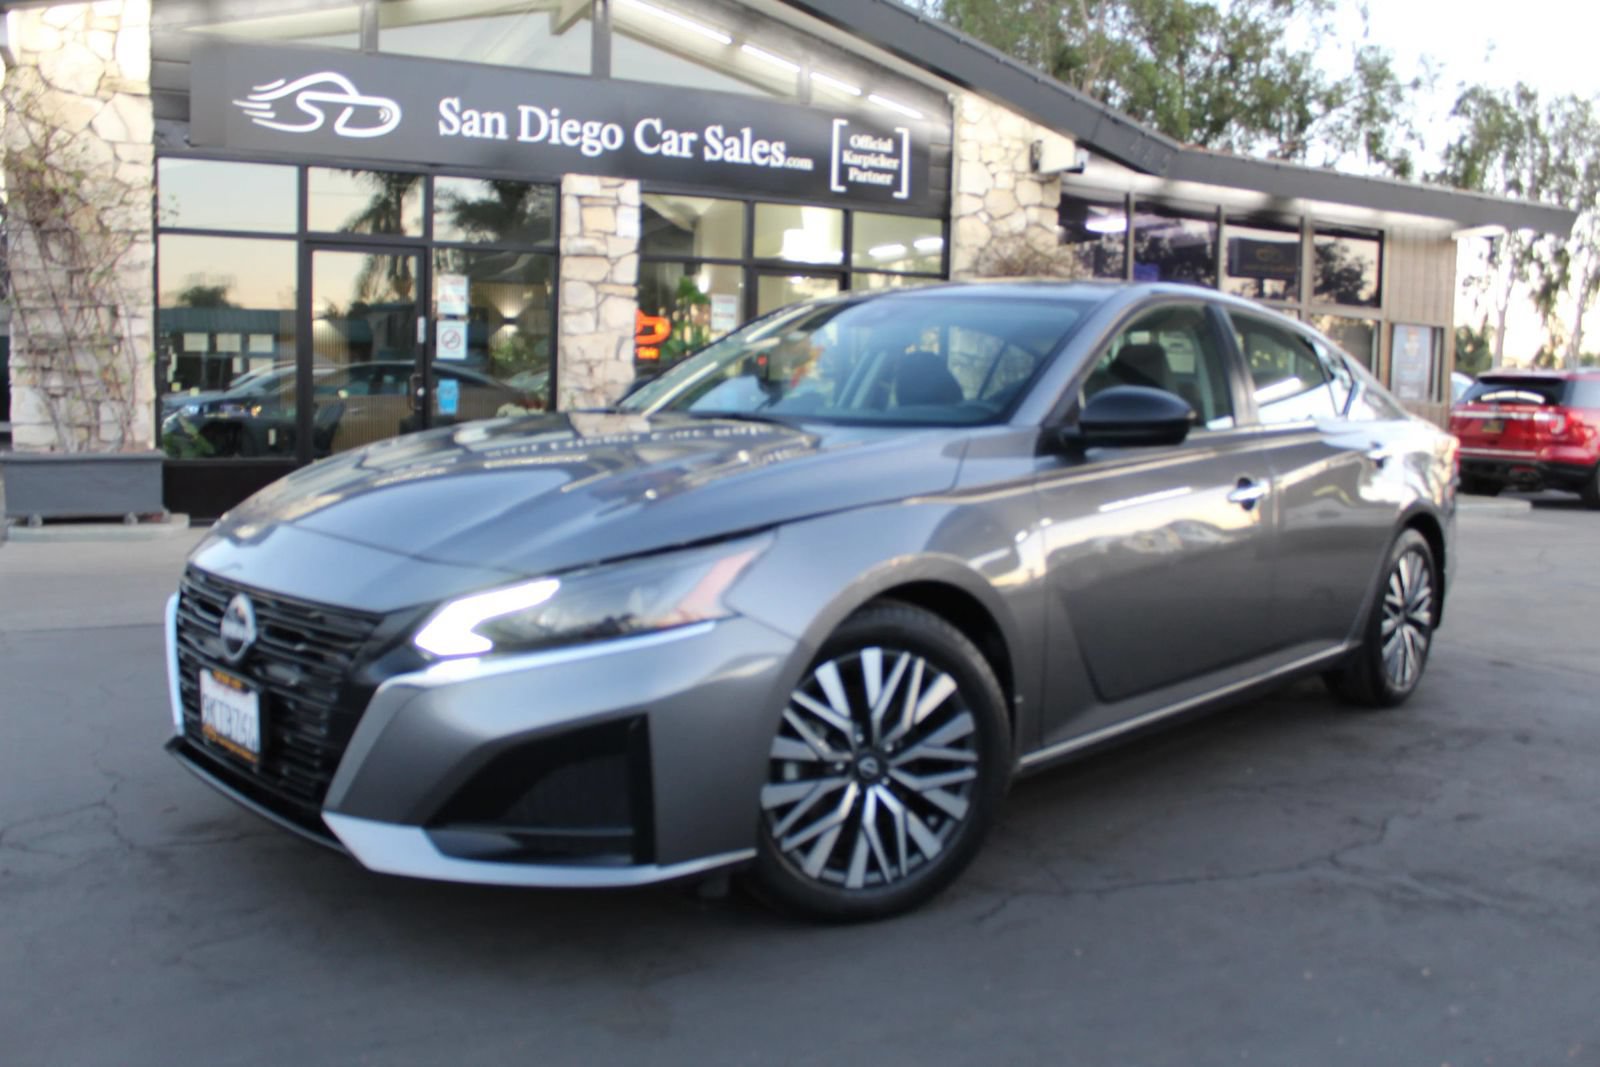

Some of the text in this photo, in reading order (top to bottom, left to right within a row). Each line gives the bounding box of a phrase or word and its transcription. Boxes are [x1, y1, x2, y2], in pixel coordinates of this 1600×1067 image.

[438, 97, 508, 140] San
[517, 104, 624, 157] Diego
[633, 117, 698, 159] Car
[849, 134, 893, 153] Official
[847, 166, 894, 186] Partner
